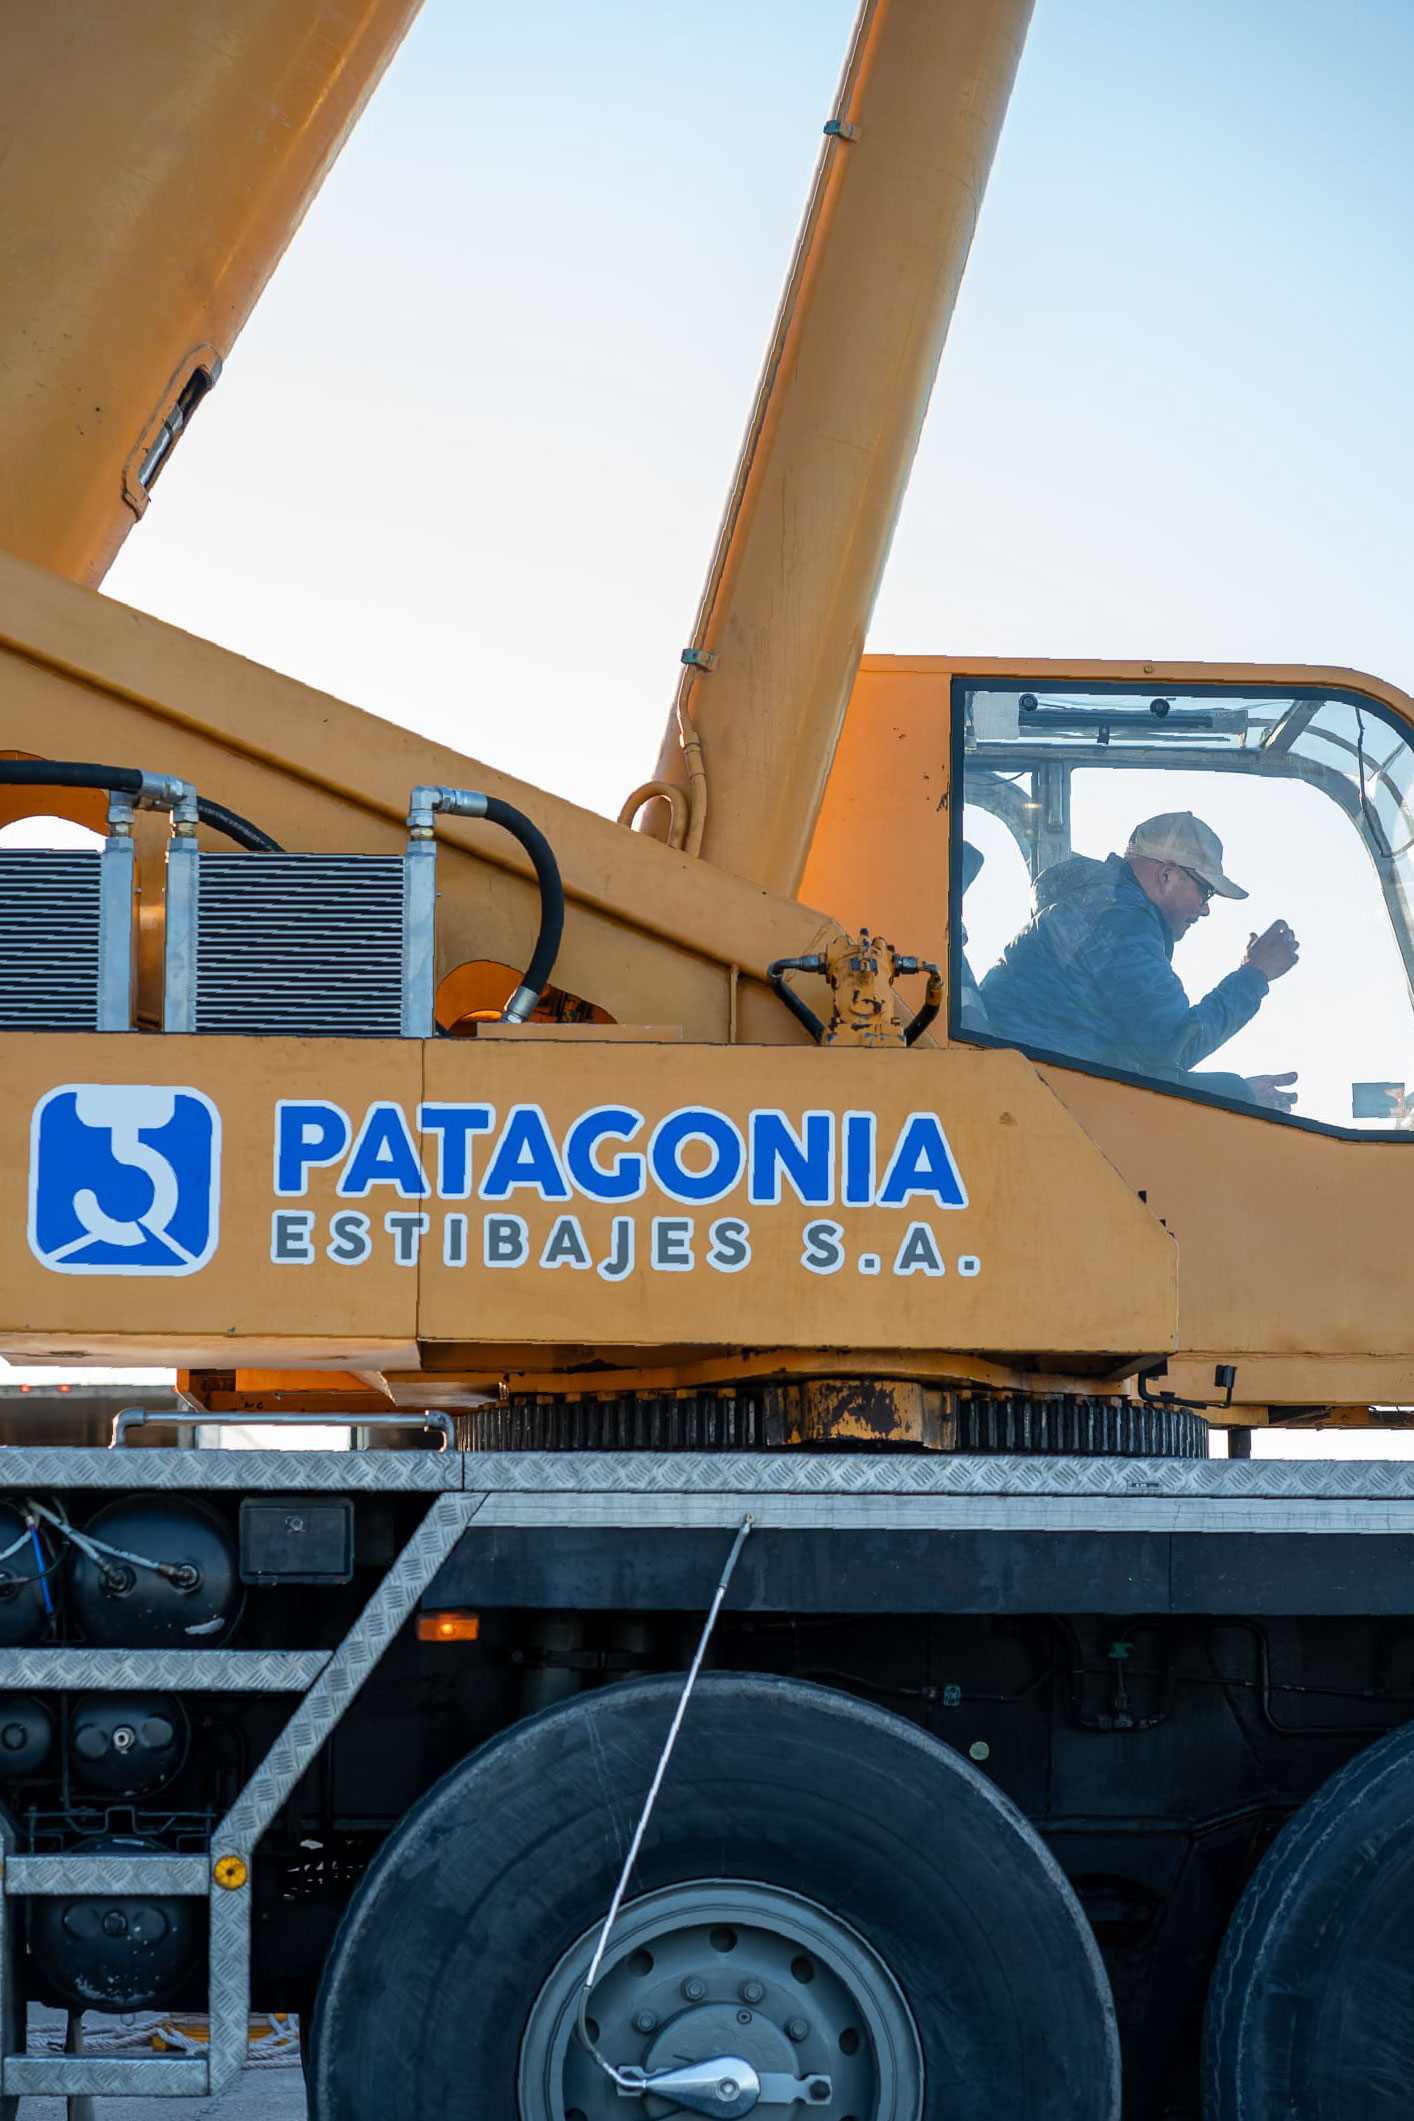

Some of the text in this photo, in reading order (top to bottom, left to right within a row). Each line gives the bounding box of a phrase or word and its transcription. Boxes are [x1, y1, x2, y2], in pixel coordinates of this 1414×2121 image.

[276, 1103, 966, 1207] PATAGONIA
[274, 1212, 978, 1279] ESTIBAJES S.A.
